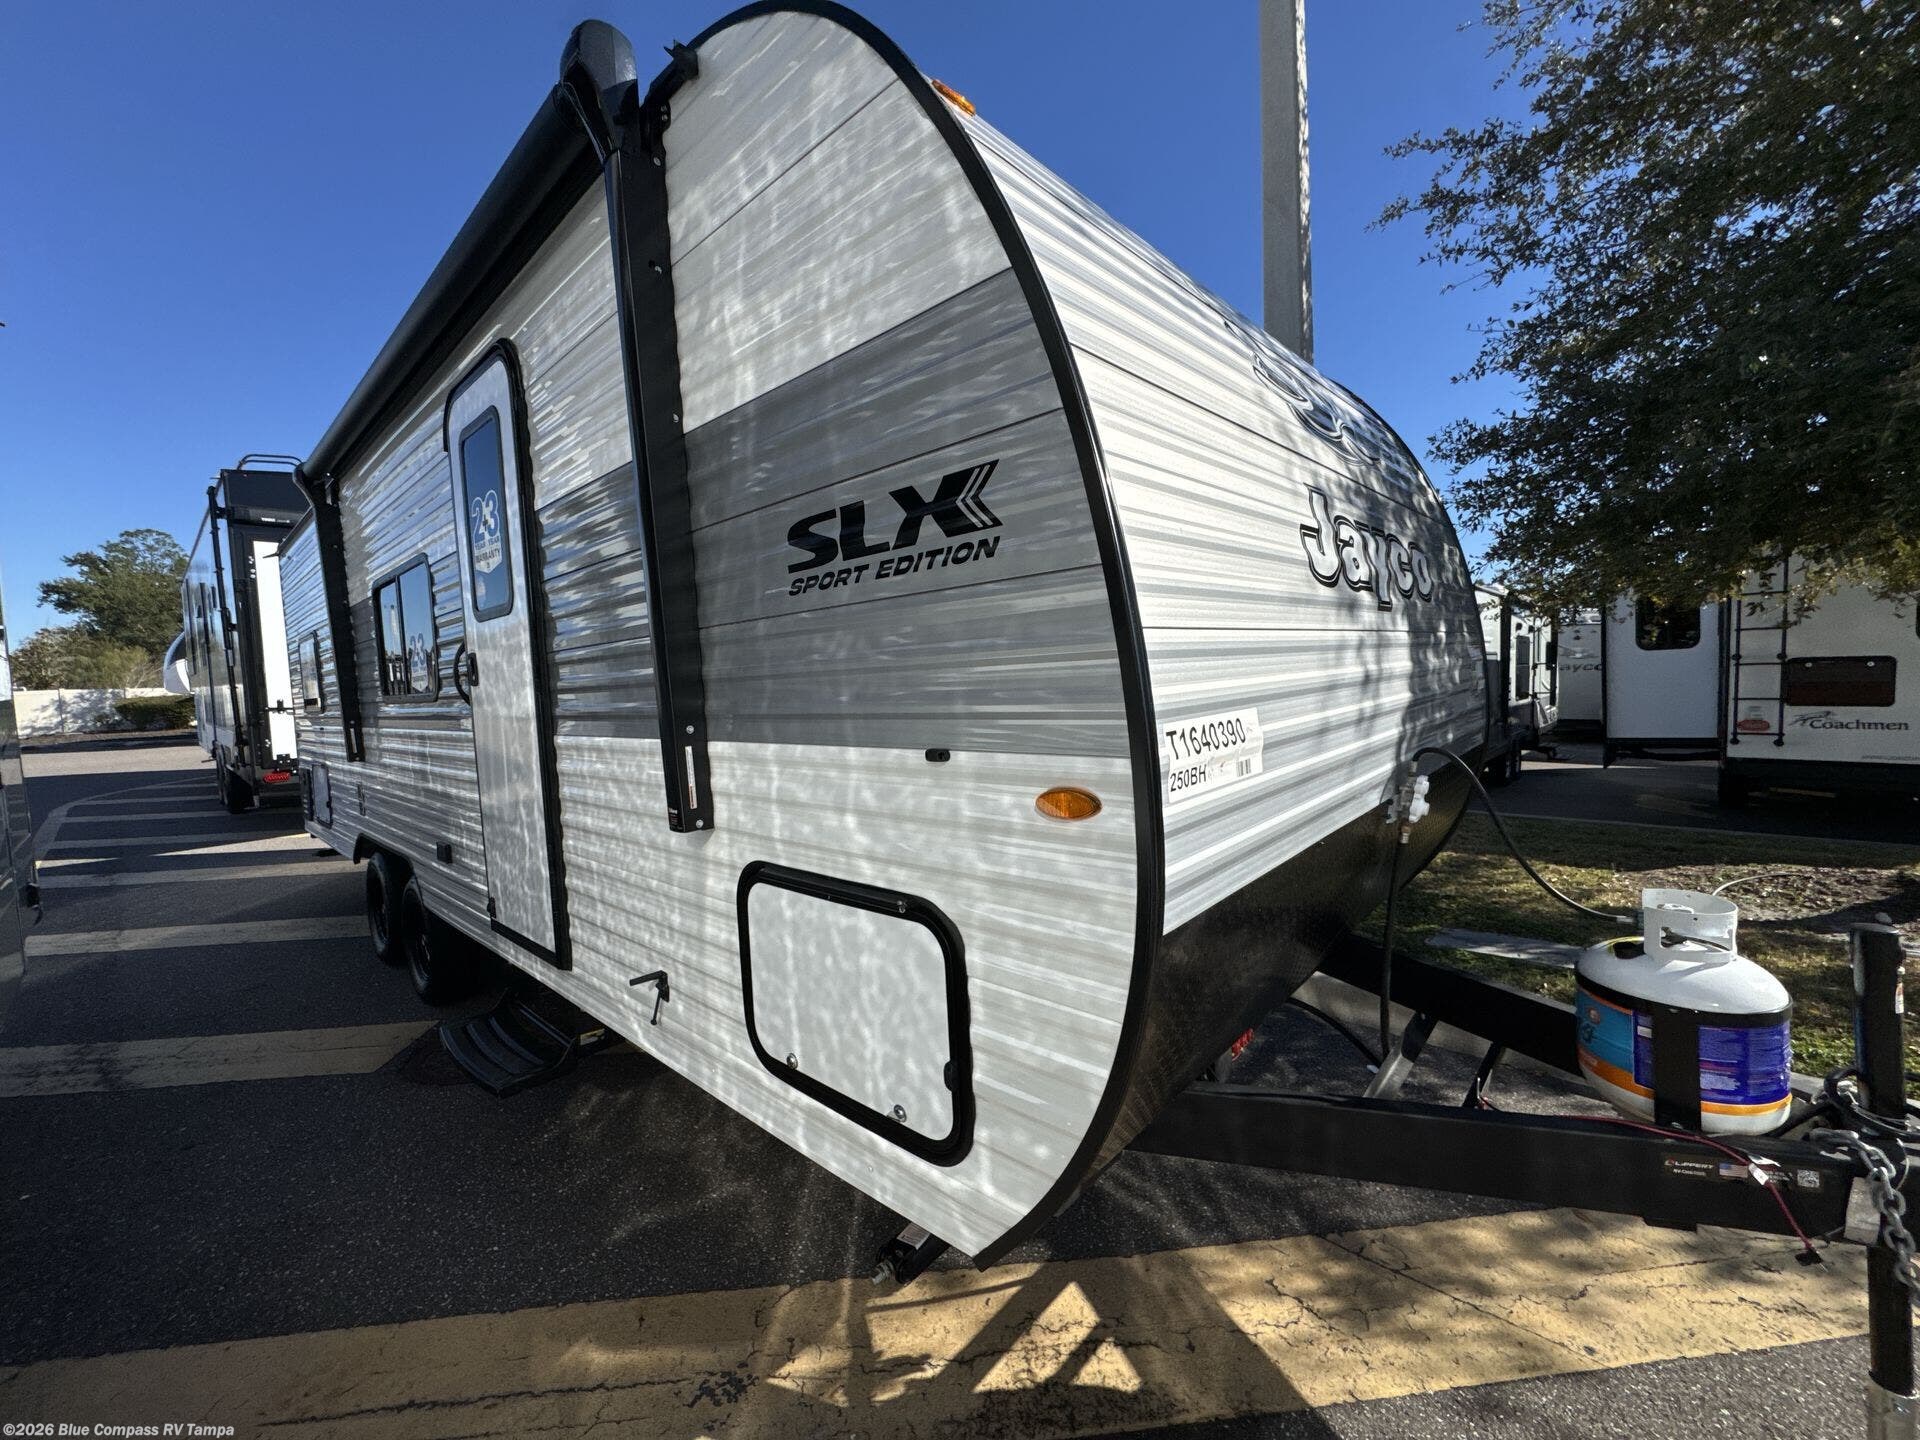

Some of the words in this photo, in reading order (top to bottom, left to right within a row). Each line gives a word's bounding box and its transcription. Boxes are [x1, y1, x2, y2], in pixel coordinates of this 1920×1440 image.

[787, 459, 1004, 574] SLX
[788, 564, 869, 596] SPORT
[875, 536, 1001, 580] EDITION
[1300, 482, 1434, 612] Jayco
[1559, 664, 1602, 672] ayco
[1165, 718, 1246, 760] T1640390
[1809, 719, 1909, 730] Coachmen
[1169, 763, 1207, 793] 250BH
